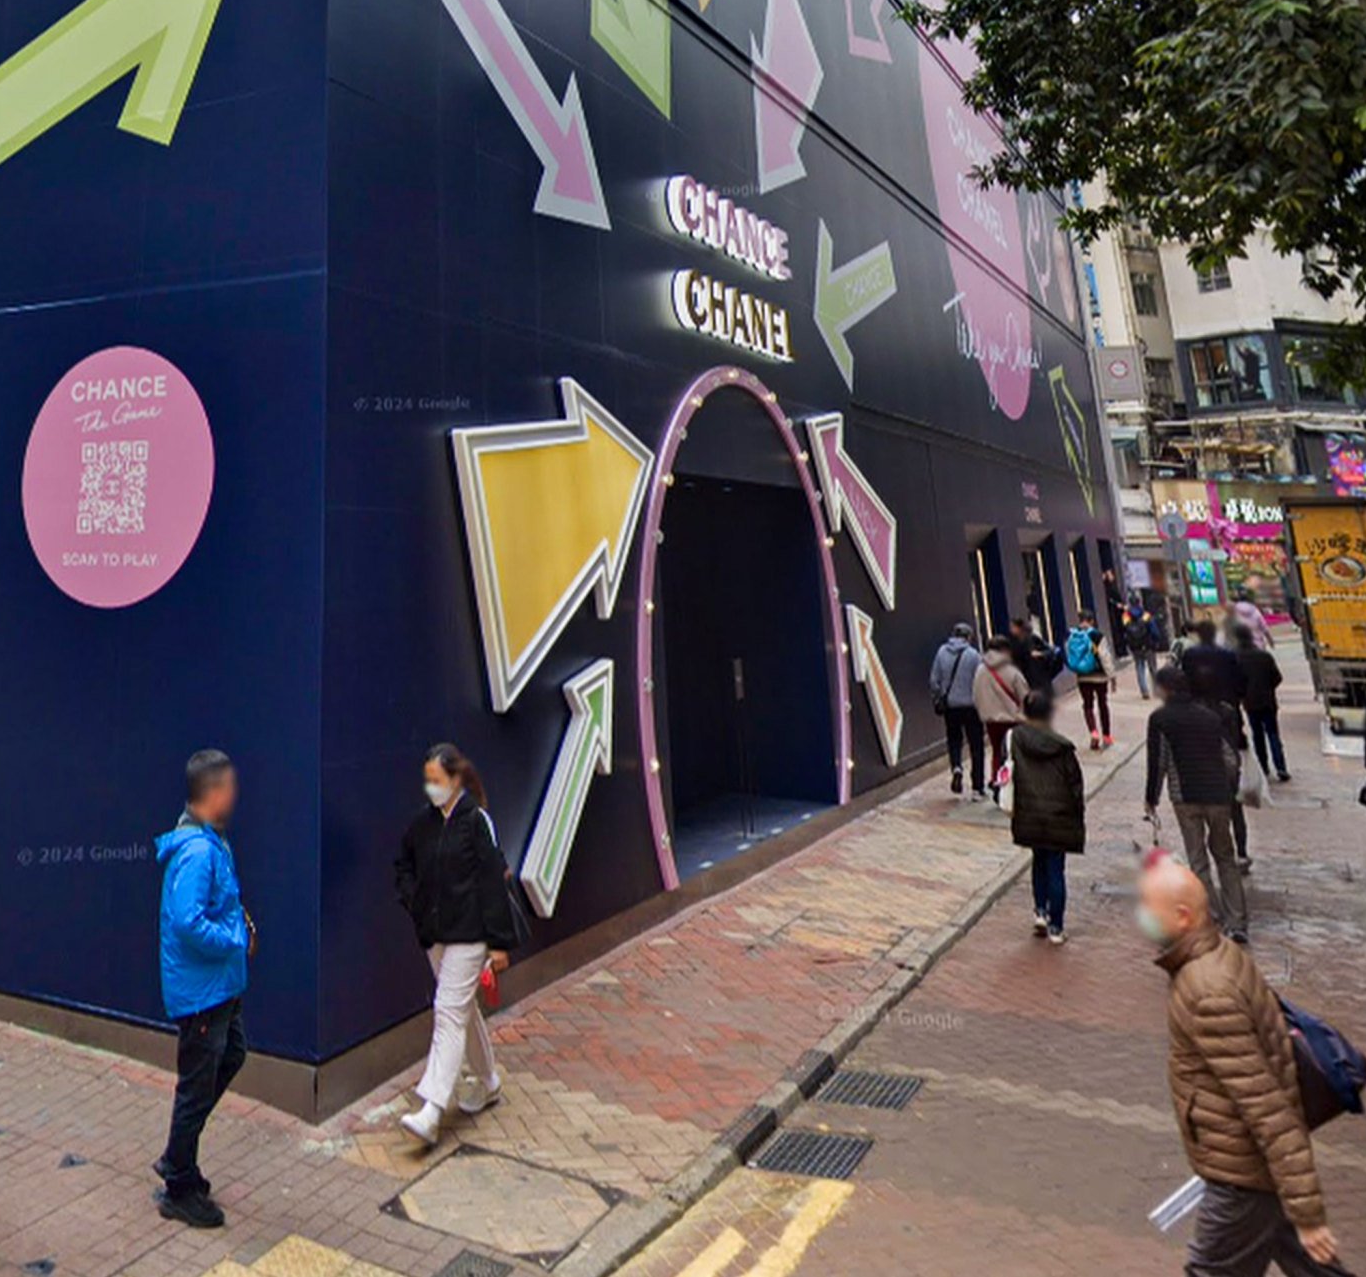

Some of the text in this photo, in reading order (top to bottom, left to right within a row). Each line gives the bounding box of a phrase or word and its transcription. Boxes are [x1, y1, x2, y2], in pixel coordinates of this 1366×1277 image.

[666, 174, 792, 281] CHANCE
[672, 269, 794, 363] CHANEL
[70, 375, 167, 403] CHANCE
[73, 402, 163, 434] The Game
[62, 552, 159, 568] SCAN TO PLAY
